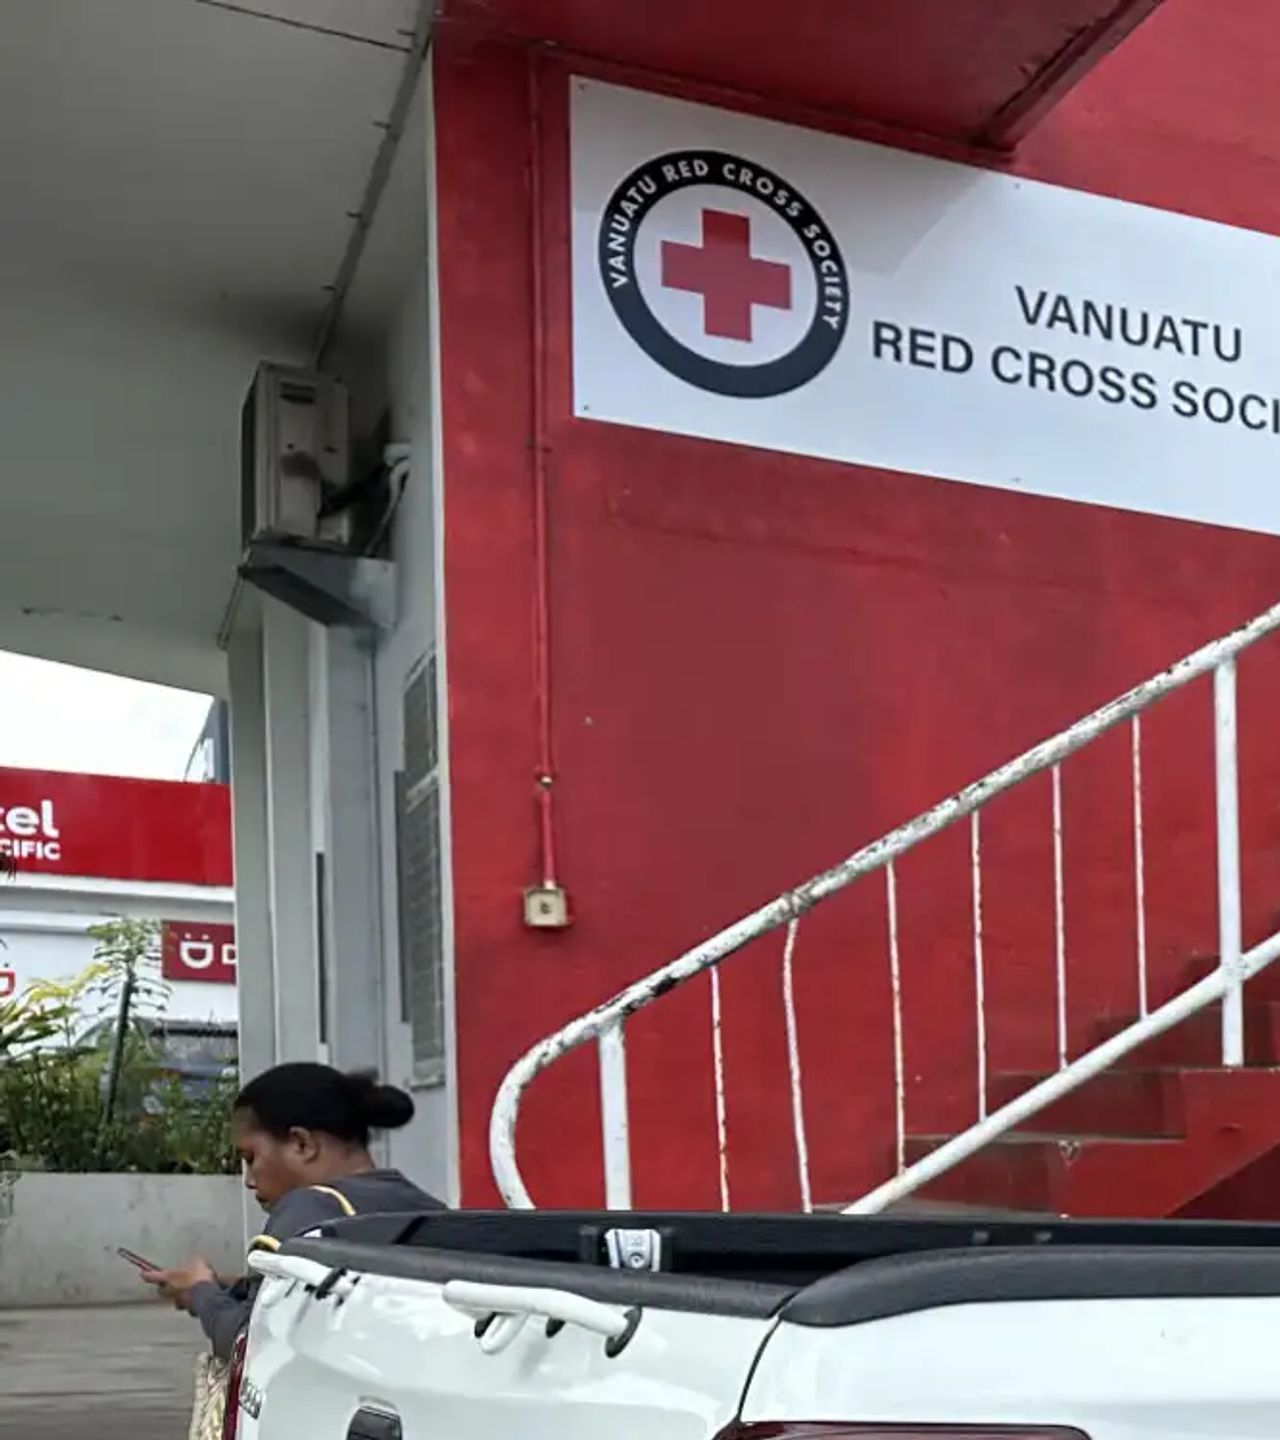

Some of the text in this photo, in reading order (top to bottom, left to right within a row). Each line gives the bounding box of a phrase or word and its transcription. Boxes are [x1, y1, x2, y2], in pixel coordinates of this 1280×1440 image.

[607, 158, 842, 331] VANUATU RED CROSS SOCIETY
[871, 320, 975, 375] RED
[990, 344, 1158, 410] CROSS
[1014, 284, 1243, 363] VANUATU
